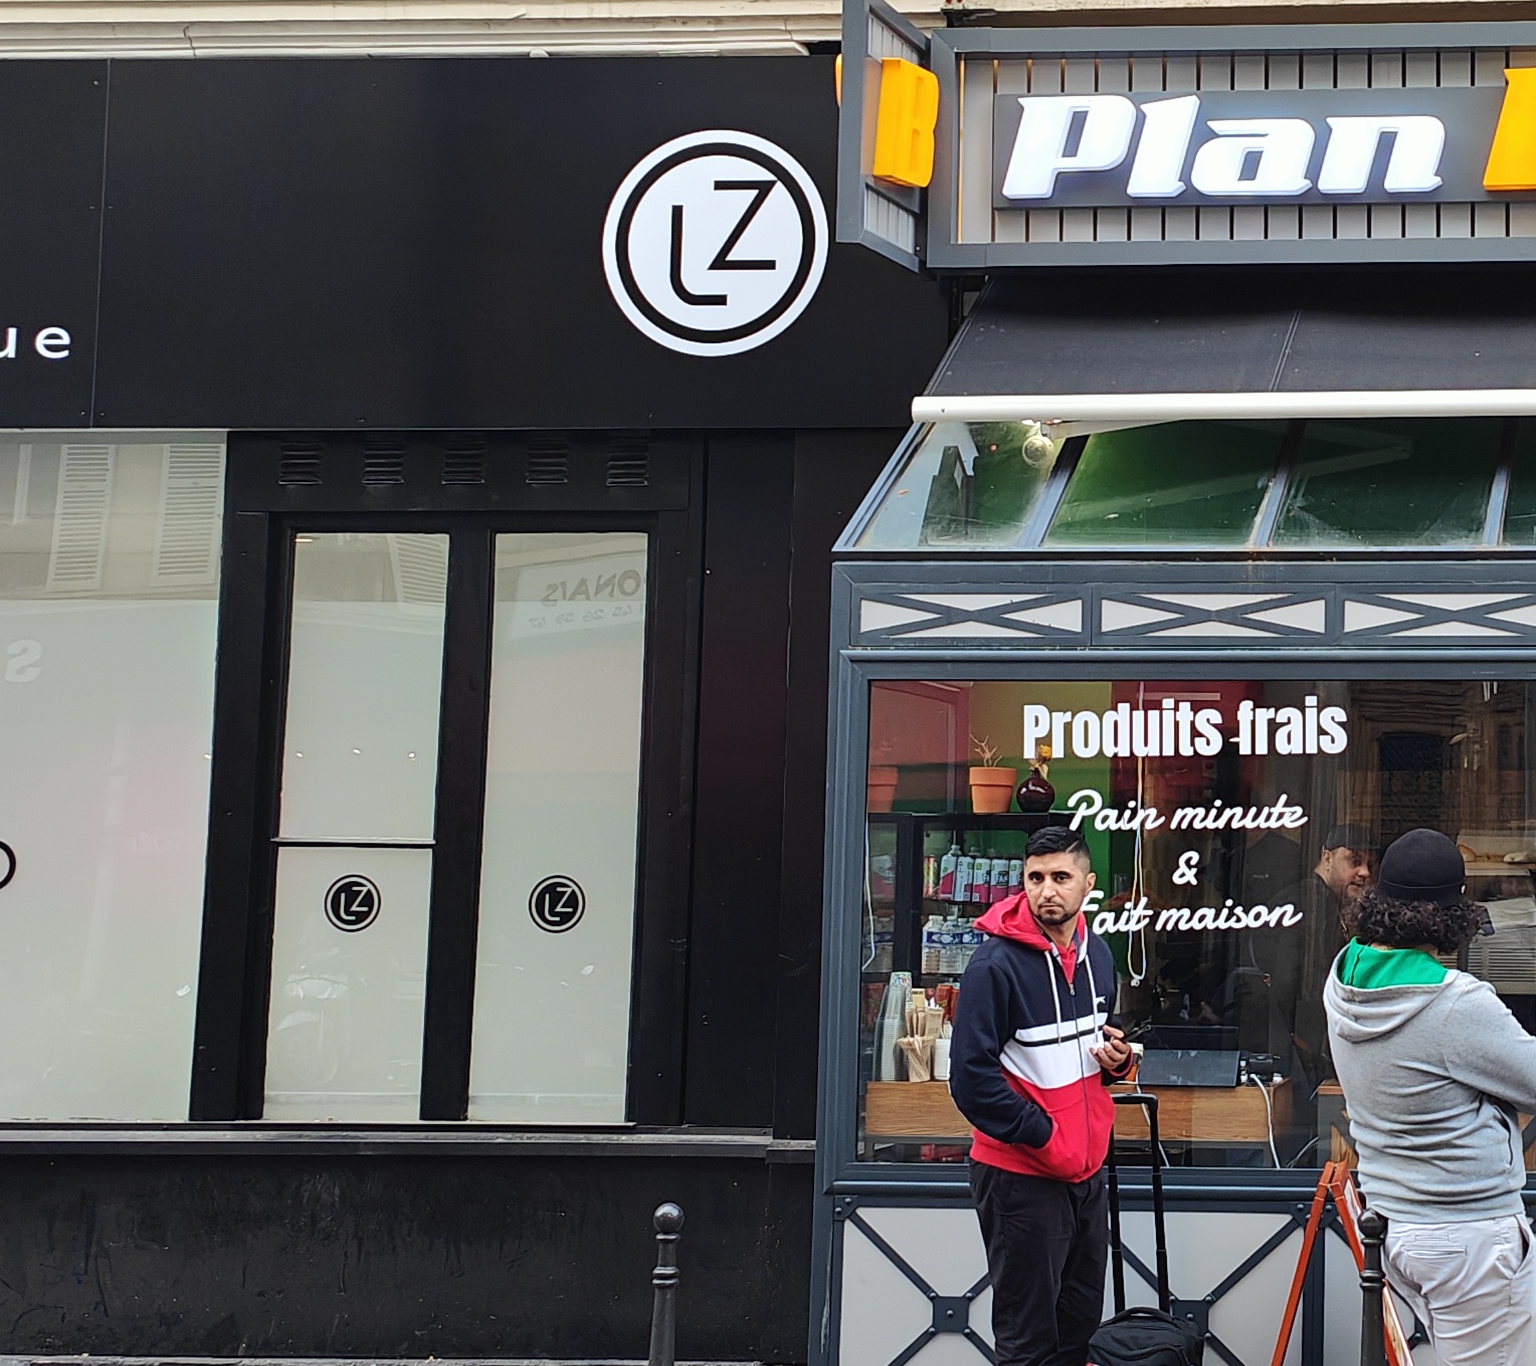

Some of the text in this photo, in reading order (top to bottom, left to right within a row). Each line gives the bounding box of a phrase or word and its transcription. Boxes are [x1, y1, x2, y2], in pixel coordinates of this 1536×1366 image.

[1002, 94, 1446, 199] Plan
[1023, 696, 1348, 759] Produits frais
[1067, 789, 1308, 832] Pain minute
[1172, 850, 1200, 886] &
[1155, 899, 1304, 931] maison
